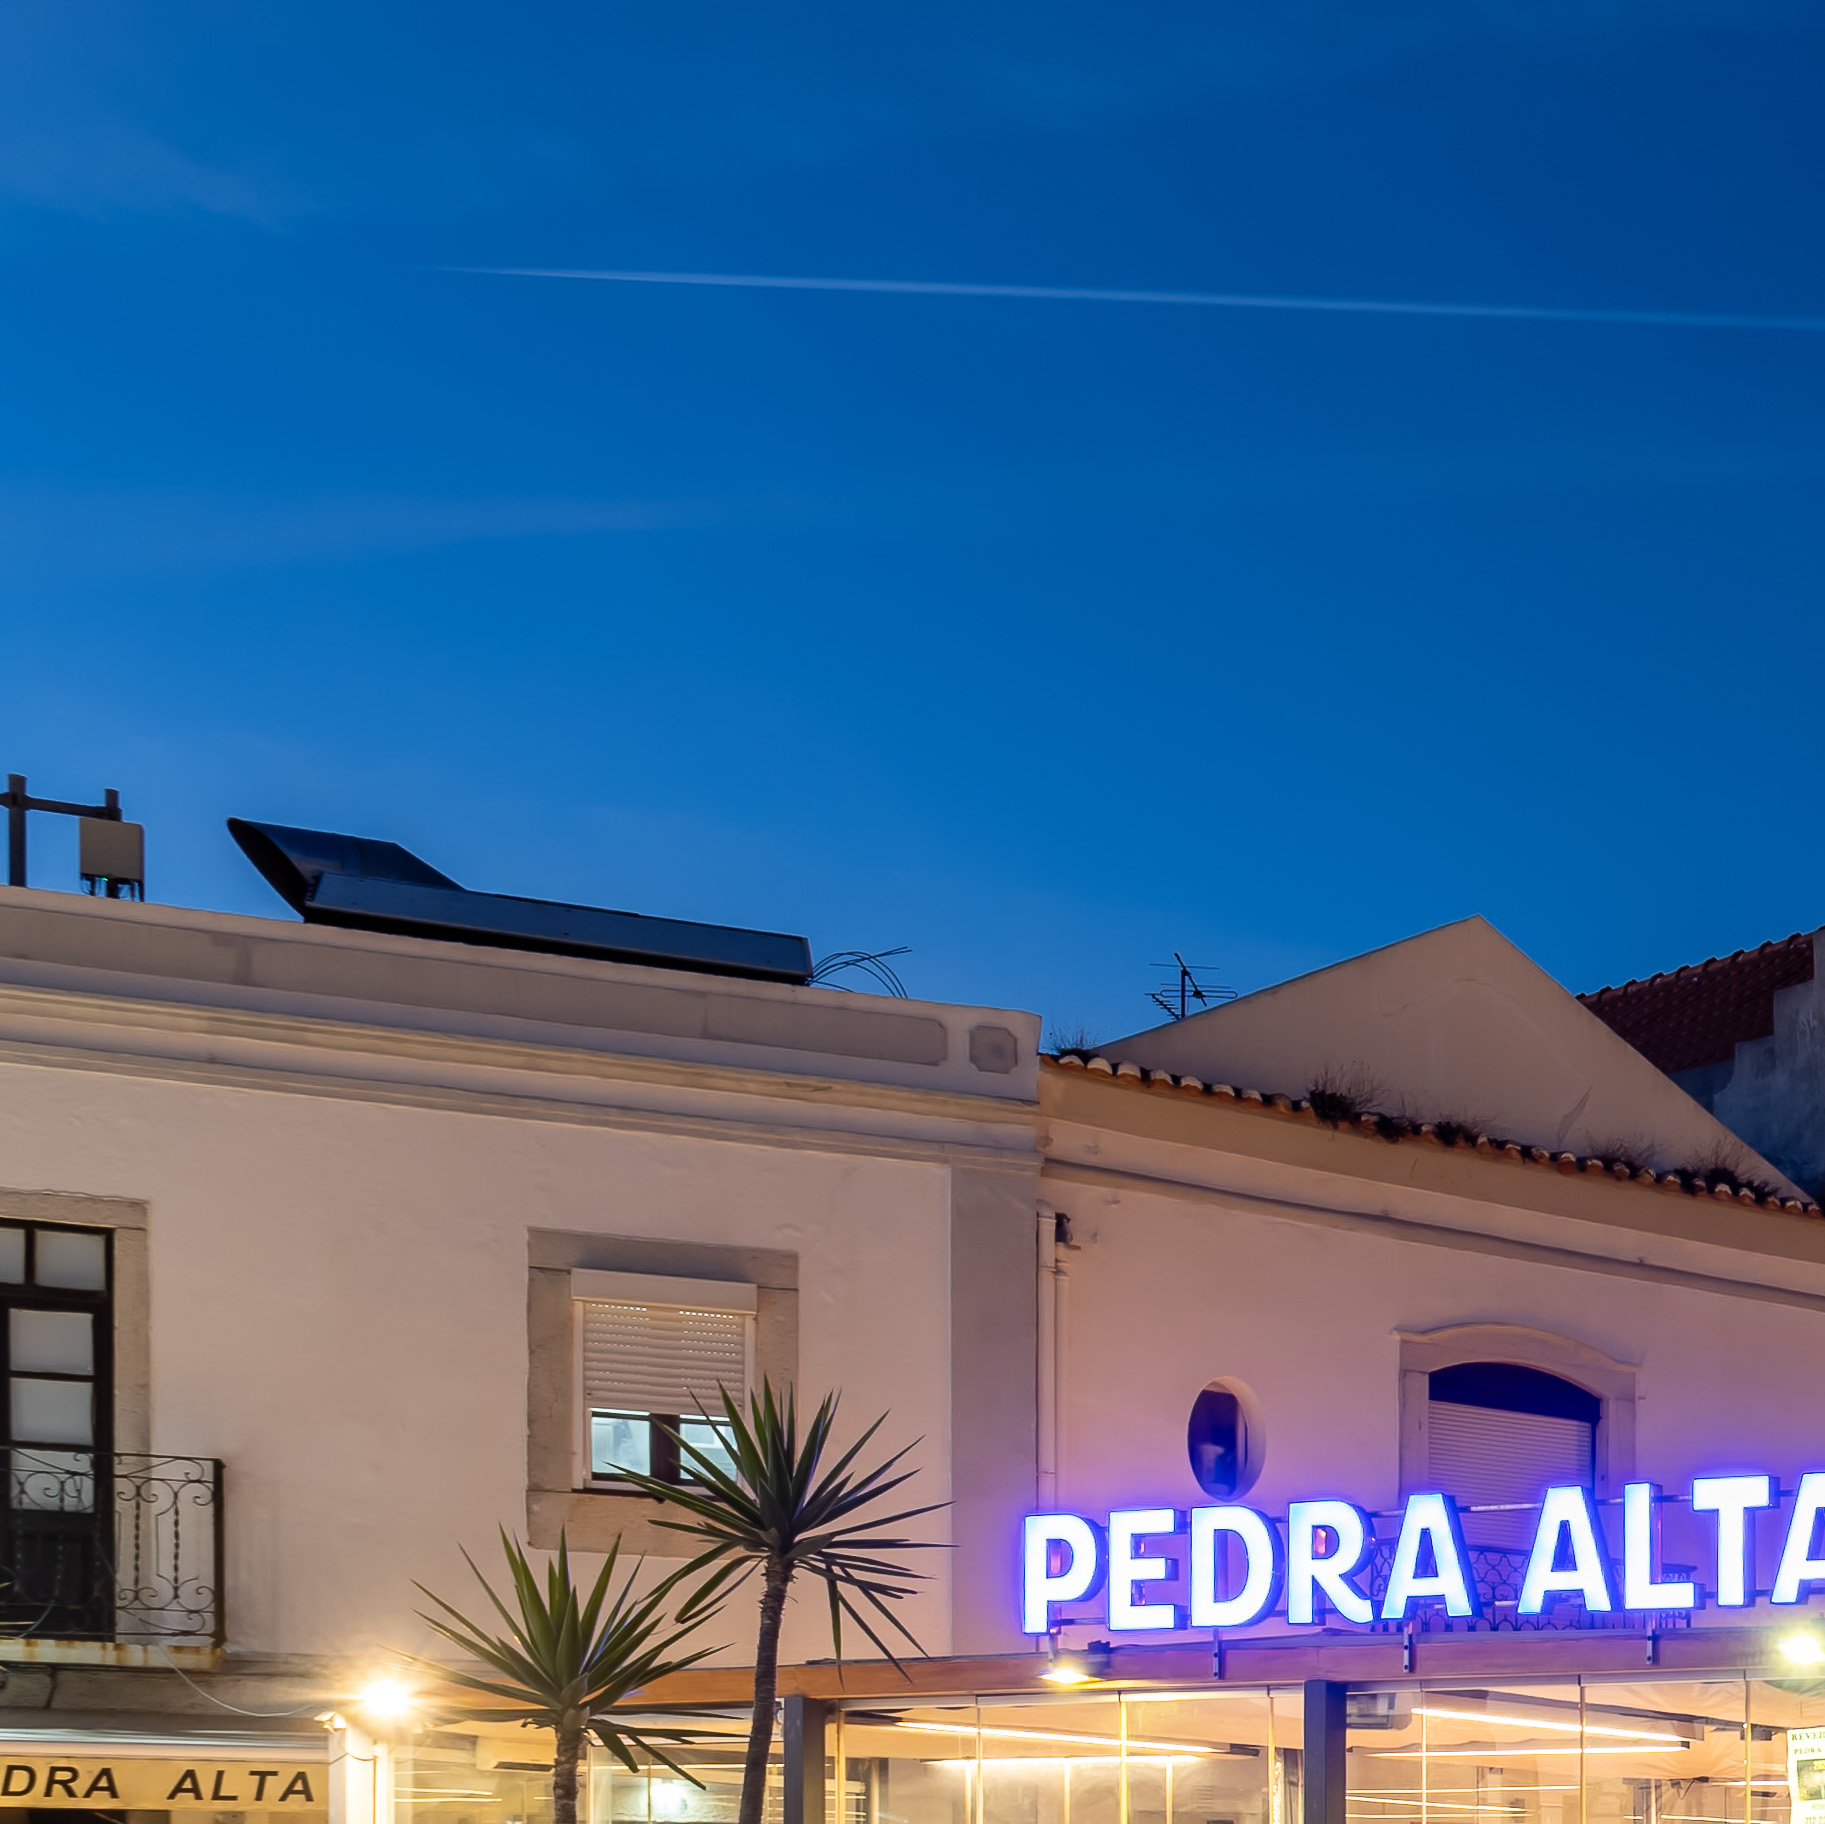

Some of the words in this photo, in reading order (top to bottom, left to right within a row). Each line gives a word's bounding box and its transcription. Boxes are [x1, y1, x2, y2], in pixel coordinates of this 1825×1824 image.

[1023, 1491, 1482, 1636] PEDRA
[1, 1764, 119, 1799] DRA
[166, 1769, 314, 1802] ALTA
